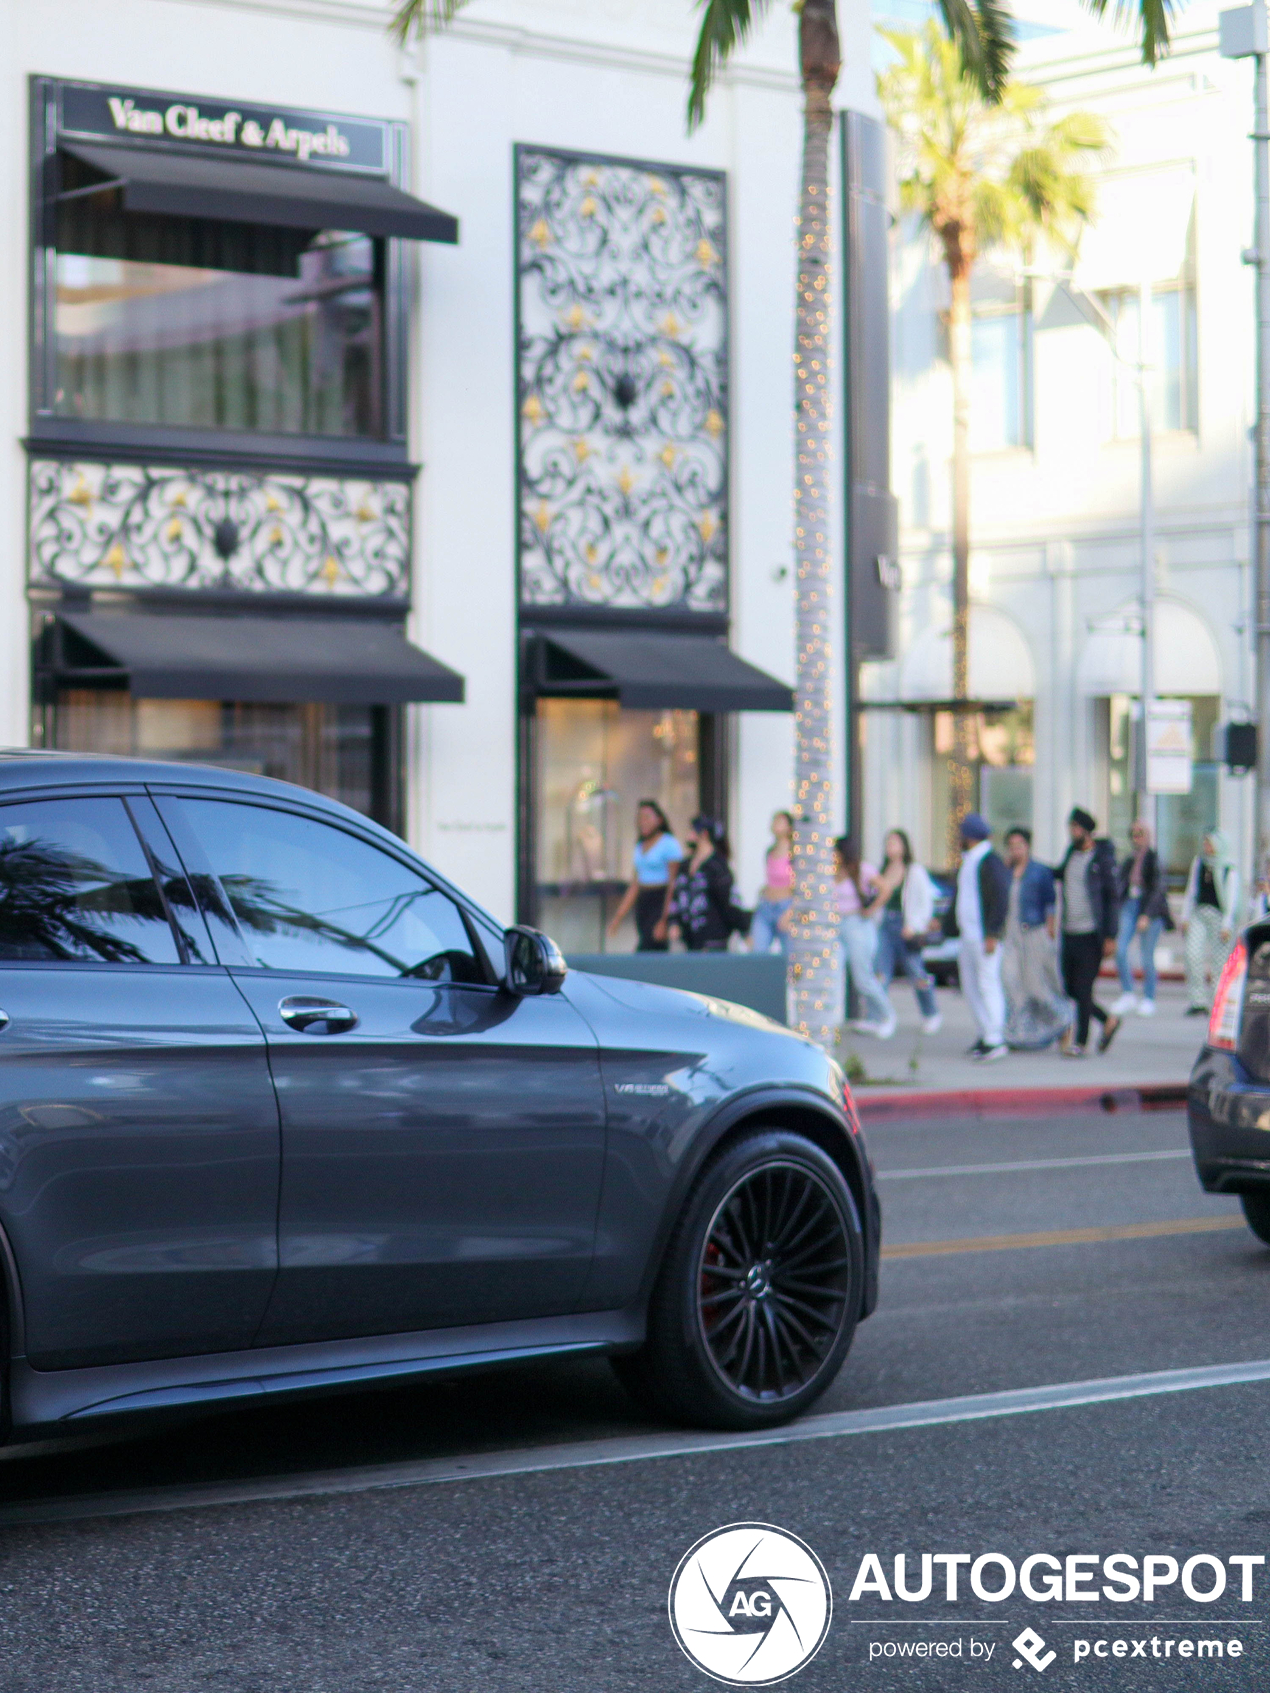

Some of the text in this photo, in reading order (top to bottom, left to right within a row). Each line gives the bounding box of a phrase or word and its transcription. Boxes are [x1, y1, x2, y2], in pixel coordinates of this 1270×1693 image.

[107, 96, 350, 161] Van Cleef & Arpels
